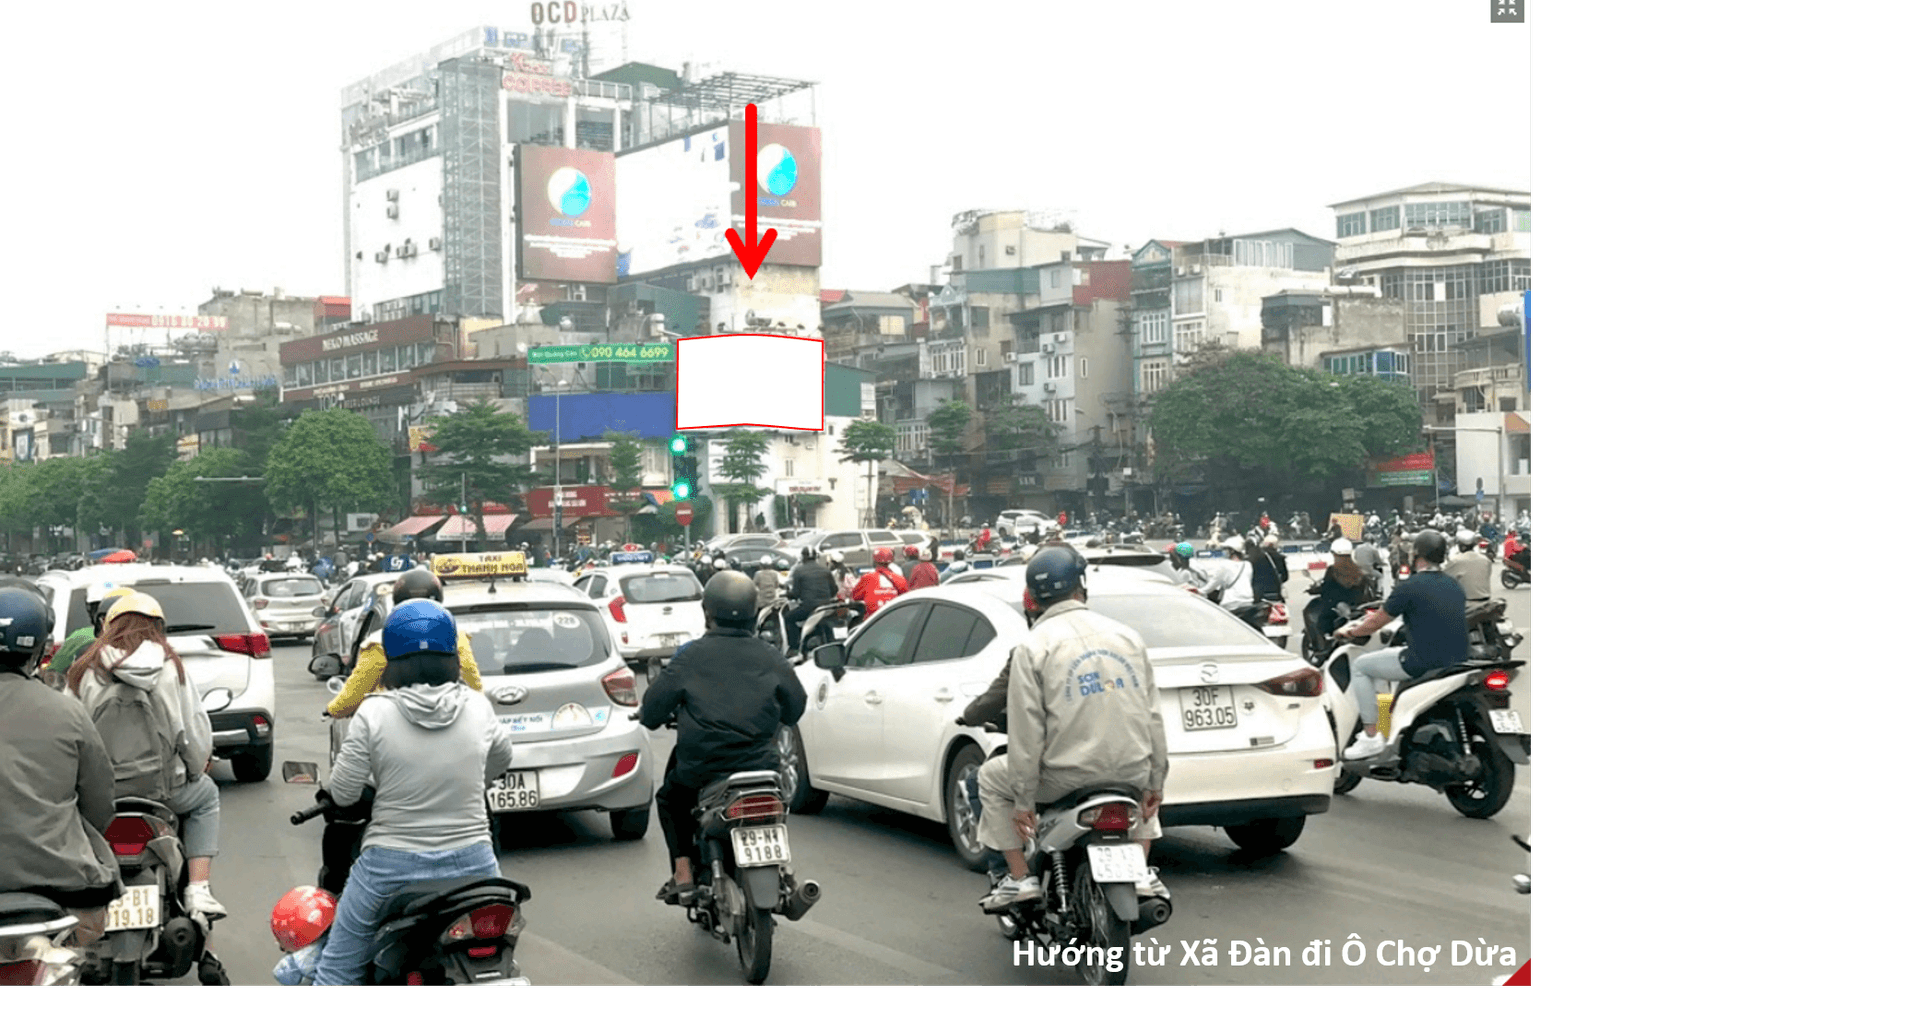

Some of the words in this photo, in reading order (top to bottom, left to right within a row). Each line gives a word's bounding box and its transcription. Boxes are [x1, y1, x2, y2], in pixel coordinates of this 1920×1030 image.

[531, 1, 577, 25] OCD
[580, 3, 631, 22] PLAZA
[1193, 688, 1218, 706] 30F
[1185, 706, 1234, 727] 963.05
[490, 790, 537, 808] 165.86
[744, 845, 782, 861] 9188
